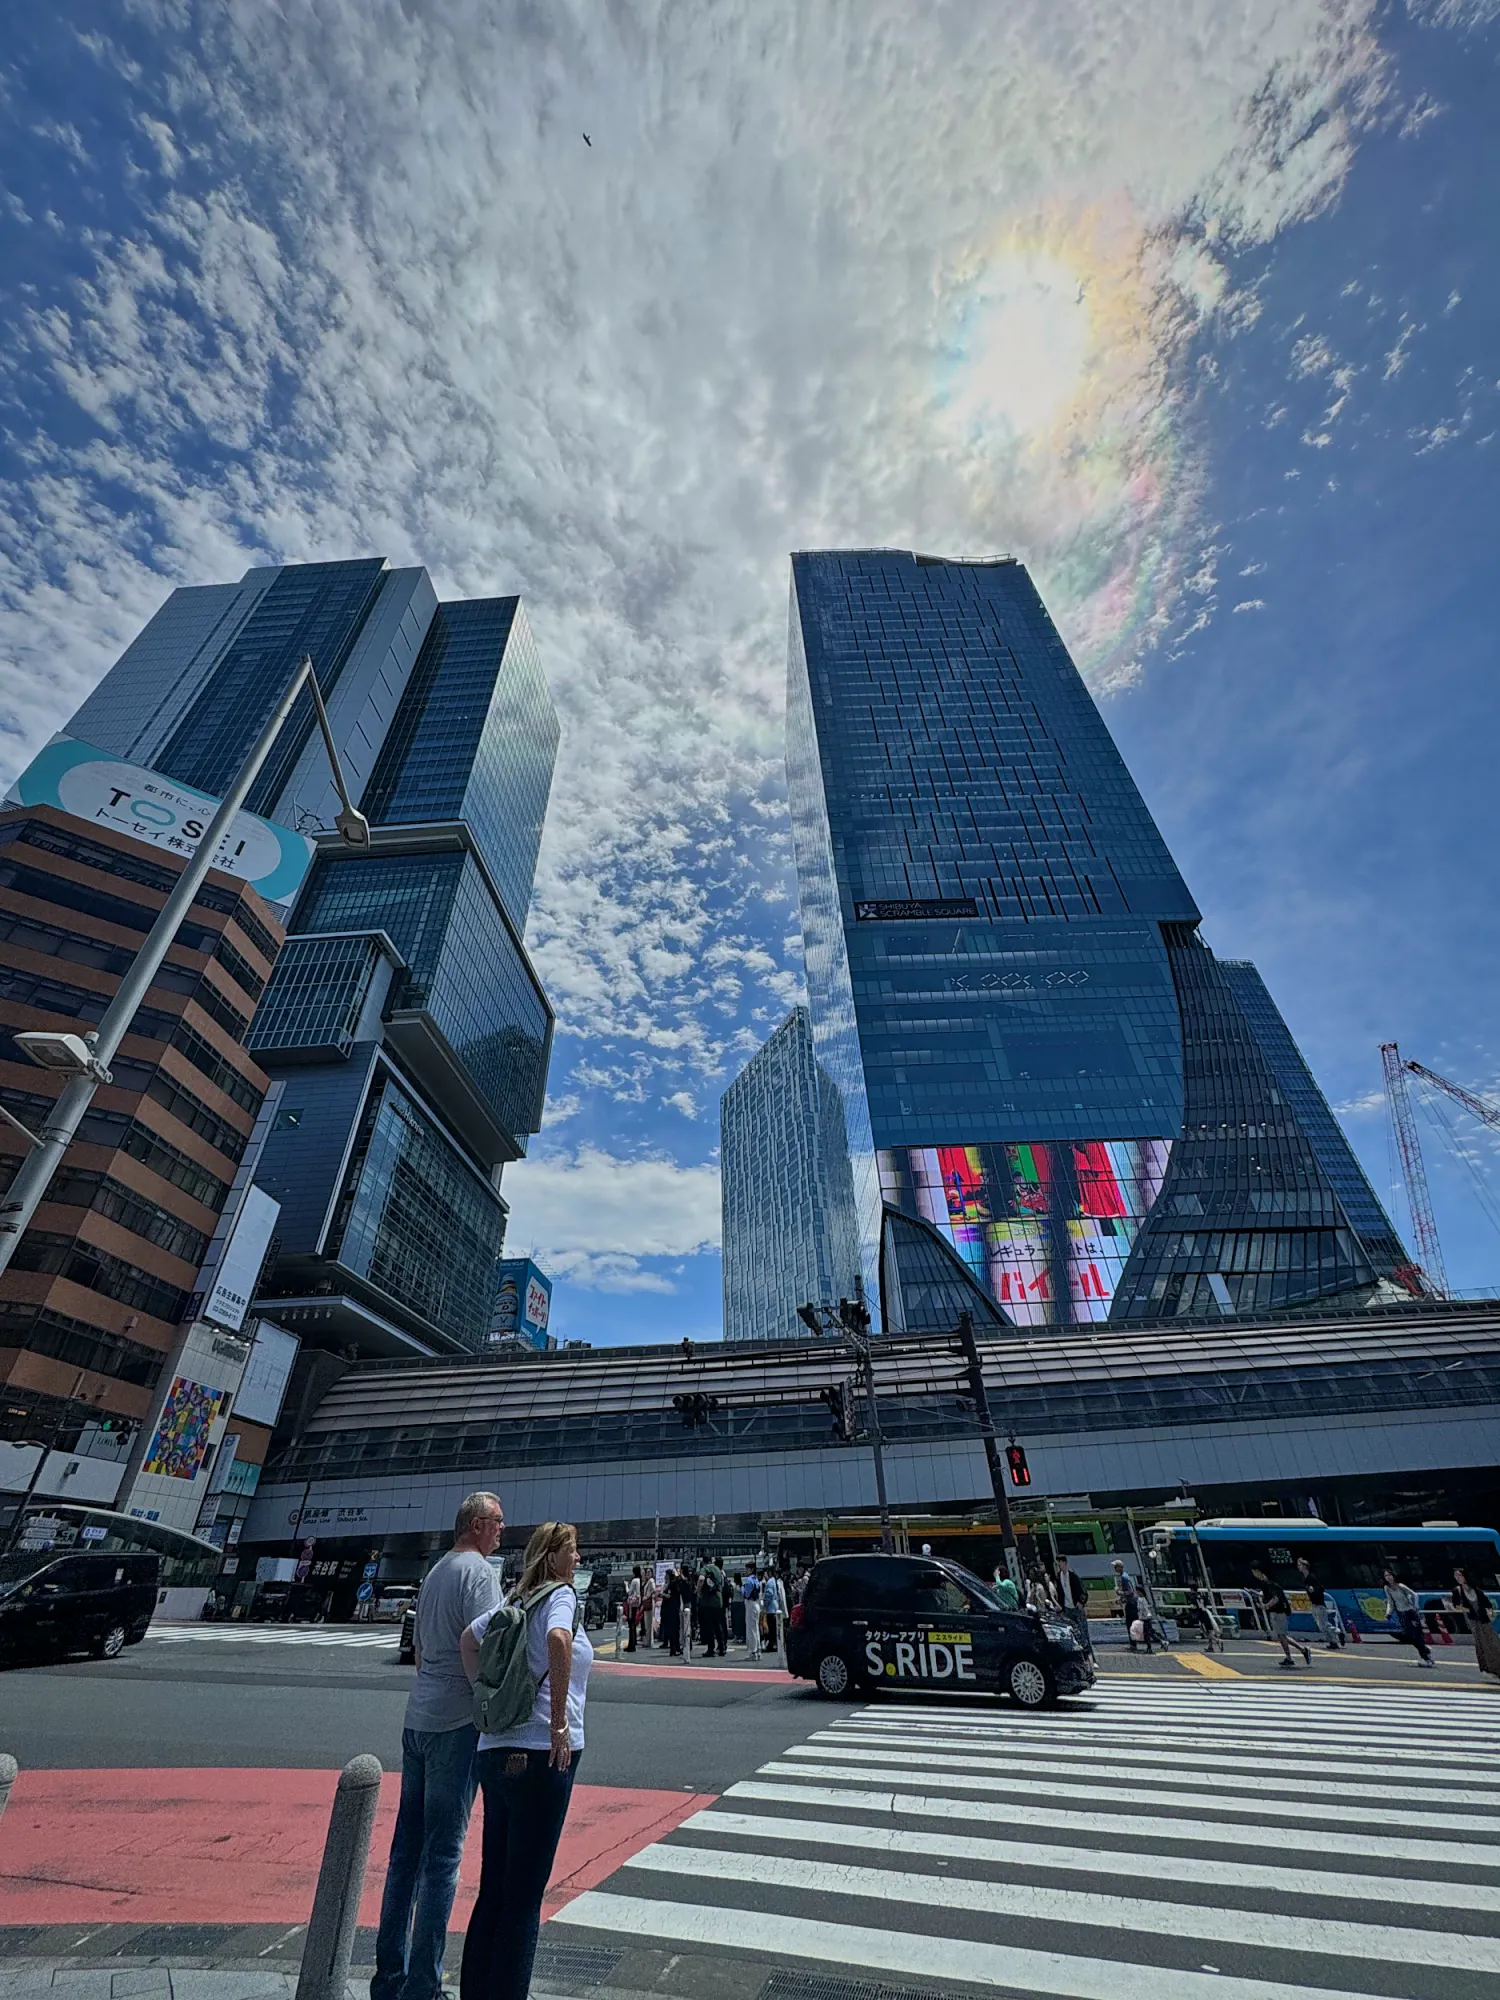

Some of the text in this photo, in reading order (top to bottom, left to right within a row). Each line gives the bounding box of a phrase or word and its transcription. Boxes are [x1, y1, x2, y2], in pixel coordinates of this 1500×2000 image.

[879, 903, 922, 911] SHIBUYA
[880, 907, 976, 918] SCRAMBLE SQUARE
[1001, 1263, 1110, 1301] バイル
[865, 1630, 925, 1642] タクシーアプリ
[865, 1641, 977, 1680] S.RIDE
